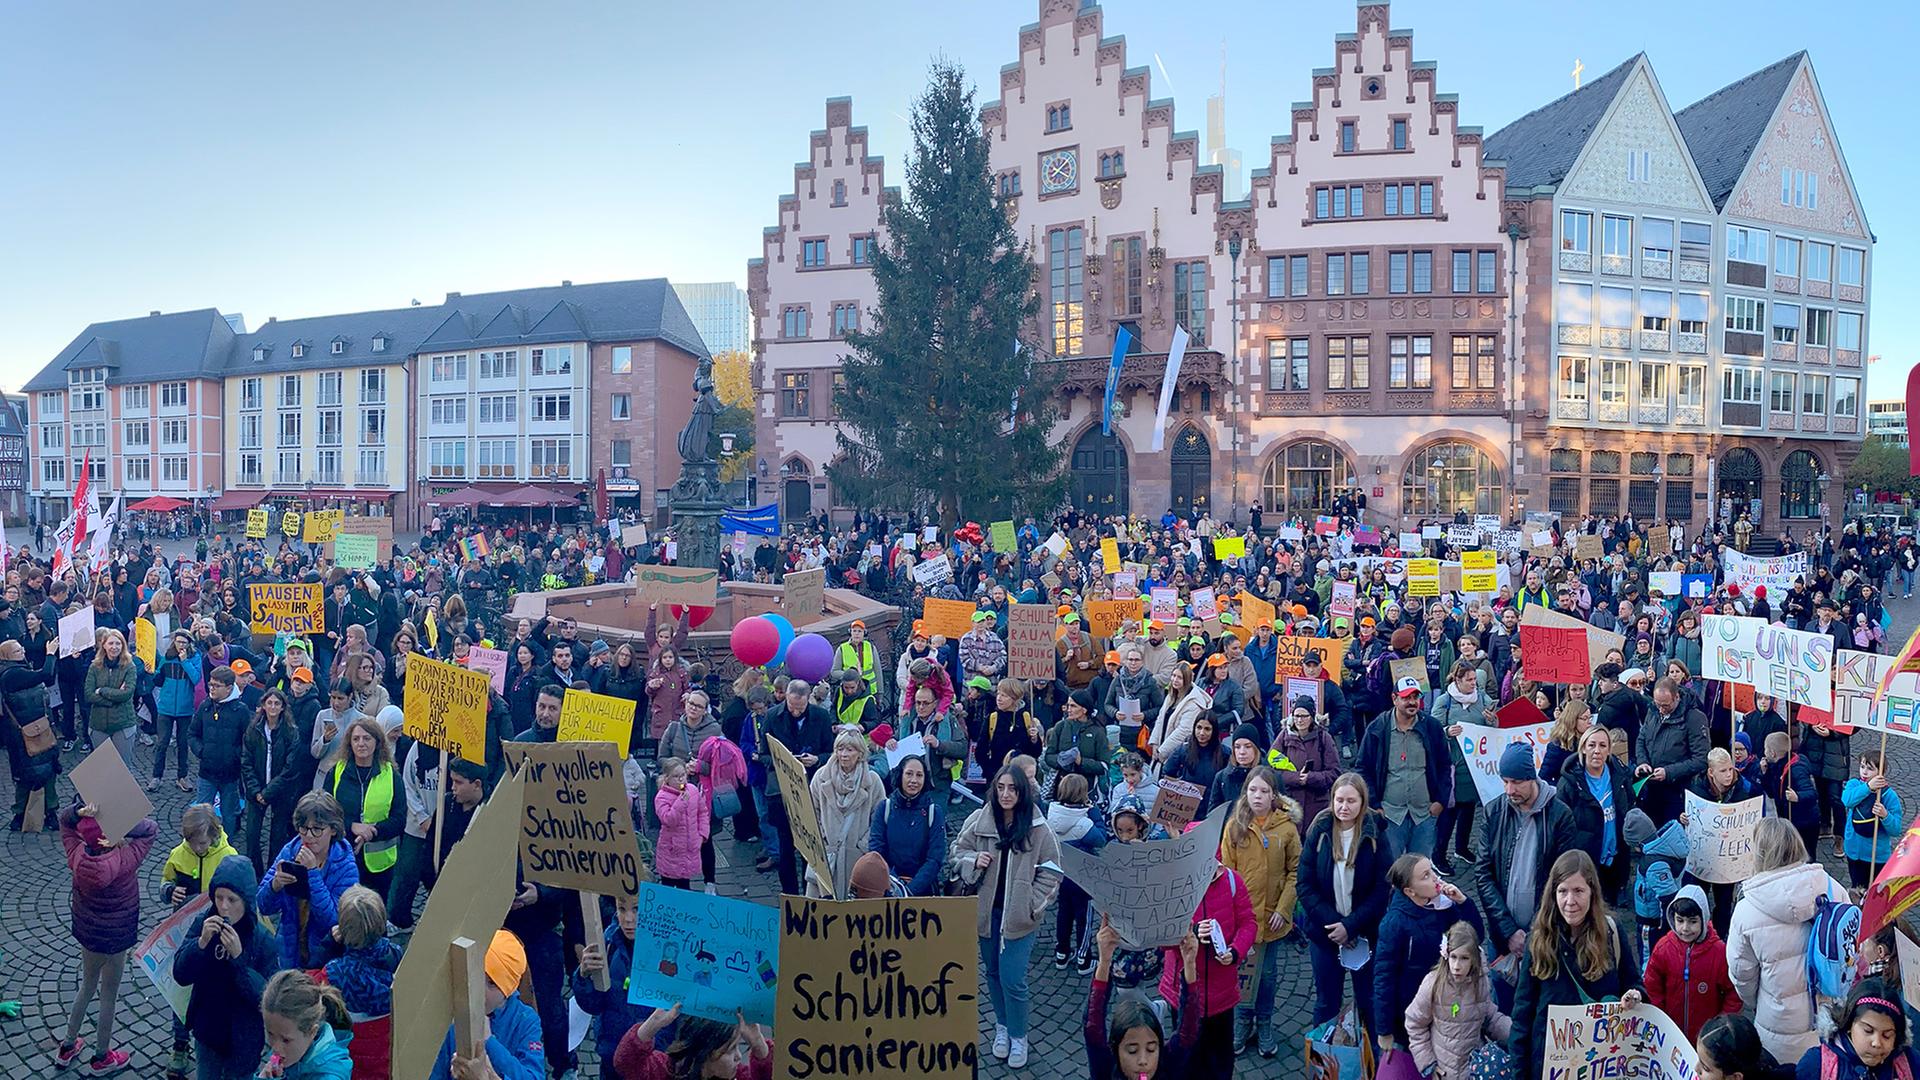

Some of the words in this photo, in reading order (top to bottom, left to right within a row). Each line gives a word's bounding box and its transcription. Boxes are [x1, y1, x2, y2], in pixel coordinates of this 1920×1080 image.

[253, 586, 313, 600] HAUSEN
[267, 600, 290, 610] LASST
[291, 601, 309, 614] IHR
[253, 603, 313, 633] SAUSEN
[1009, 609, 1055, 624] SCHULE
[1701, 615, 1739, 642] WO
[1010, 629, 1052, 642] RAUM
[1756, 626, 1832, 673] UNS
[1011, 647, 1053, 659] BILDUNG
[1717, 645, 1756, 684] IST
[409, 658, 488, 694] GYMNASIUM
[1009, 660, 1055, 679] TRAUM
[1769, 664, 1812, 706] ER
[412, 673, 481, 711] RÖMERHOF
[429, 696, 450, 713] RAUS
[429, 709, 444, 725] AUS
[566, 692, 636, 724] TURNHALLEN
[409, 724, 463, 758] CONTAINER
[429, 722, 447, 739] DEM
[585, 719, 606, 733] ALLE
[552, 749, 613, 782] wollen
[556, 782, 587, 805] die
[523, 805, 627, 842] Schulhof-
[1718, 837, 1751, 857] LEER
[527, 843, 639, 896] Sanierung
[785, 899, 839, 940] Wir
[845, 898, 943, 941] wollen
[681, 931, 707, 954] für
[849, 939, 902, 980] die
[792, 961, 975, 1022] Schulhof-
[1550, 1018, 1584, 1051] WIR
[787, 1026, 979, 1080] Sanierung
